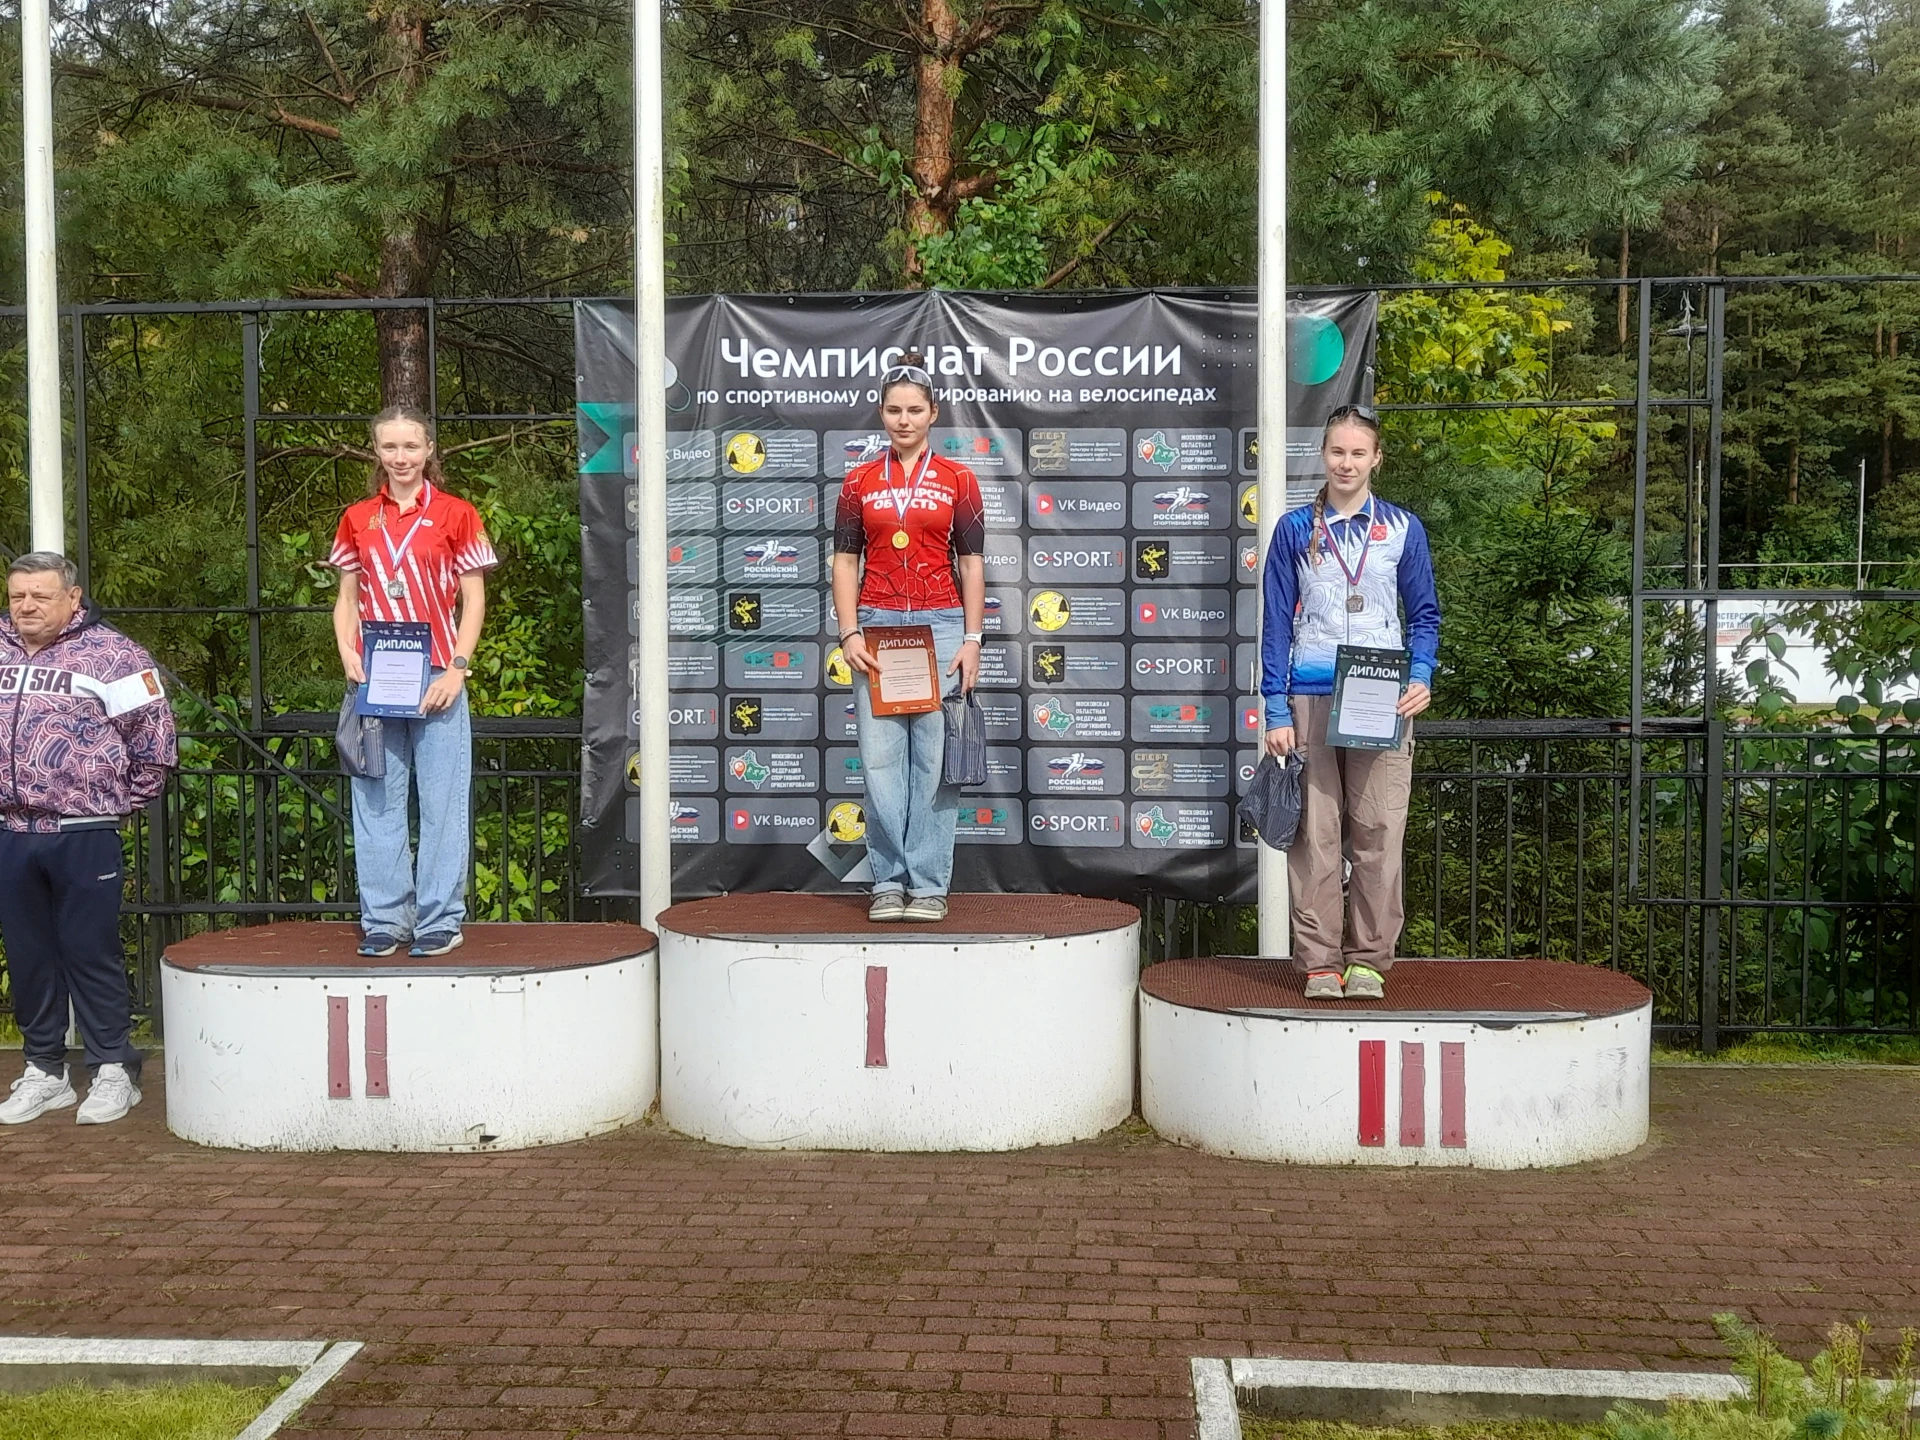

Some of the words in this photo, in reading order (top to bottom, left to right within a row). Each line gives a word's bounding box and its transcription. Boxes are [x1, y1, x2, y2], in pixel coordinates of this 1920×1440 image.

[1009, 336, 1181, 377] России
[697, 389, 719, 404] по
[725, 389, 860, 407] спортивному
[866, 388, 1041, 407] оированию
[1049, 388, 1073, 402] на
[1079, 386, 1217, 406] велосипедах
[673, 449, 711, 461] Видео
[862, 487, 954, 506] ВЛАДМРСКАЯ
[873, 498, 938, 511] ОБСТЬ
[1057, 500, 1077, 511] VK
[1079, 500, 1121, 512] Видео
[1153, 512, 1210, 520] РОССИЙСКИЙ
[984, 555, 1017, 566] идео
[743, 565, 799, 573] РОССИЙСКИЙ
[1160, 608, 1180, 619] VK
[1182, 608, 1225, 621] Видео
[374, 639, 423, 651] ДИПЛОМ
[878, 638, 926, 650] ДИПЛОМ
[1347, 664, 1400, 680] ДИПЛОМ
[1048, 777, 1104, 786] РОССИЙСКИЙ
[753, 815, 771, 826] VK
[773, 815, 815, 827] Видео
